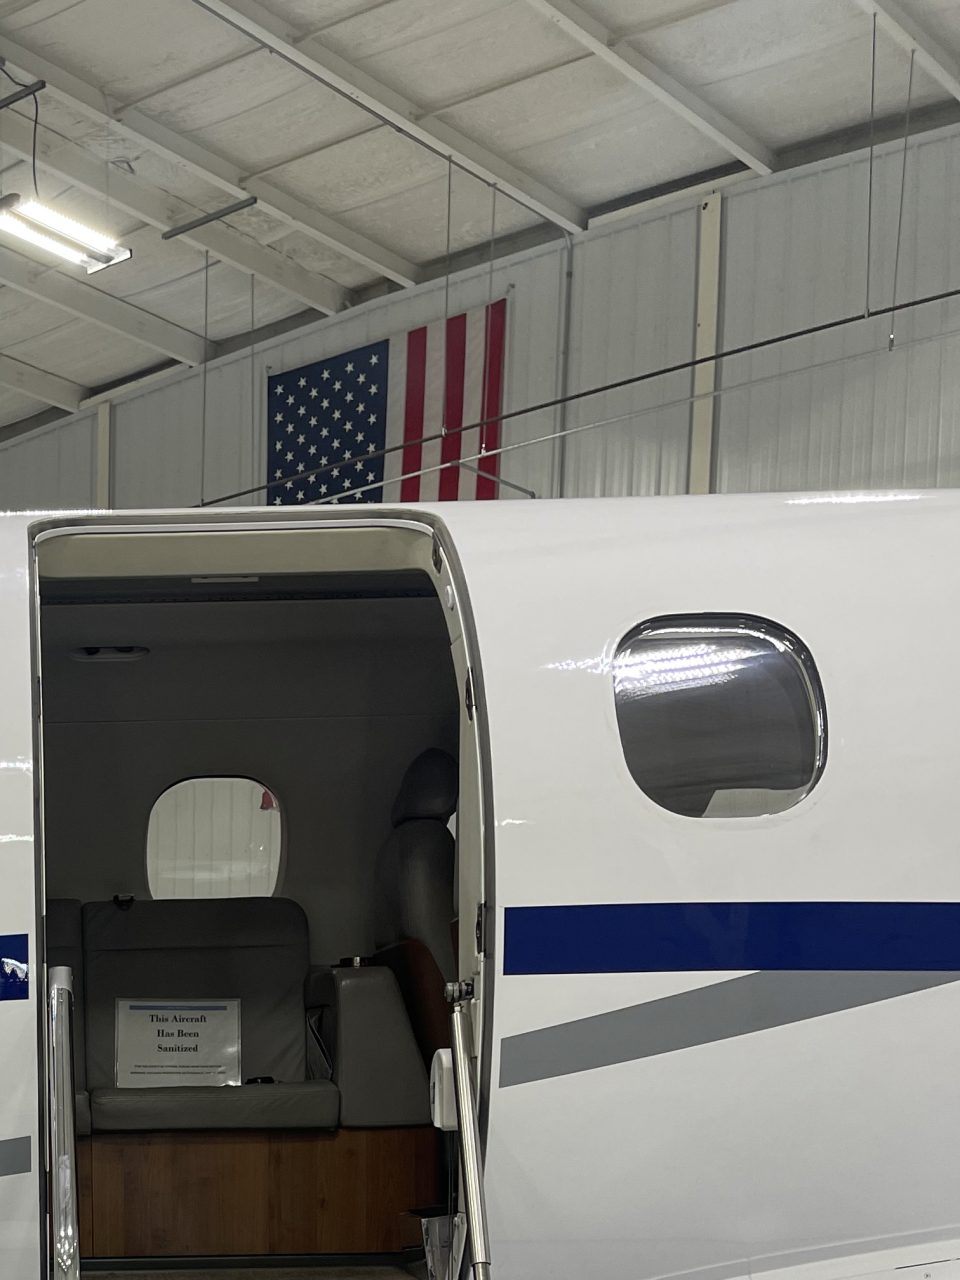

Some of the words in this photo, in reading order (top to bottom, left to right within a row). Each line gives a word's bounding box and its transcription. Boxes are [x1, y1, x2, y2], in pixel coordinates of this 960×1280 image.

[149, 1014, 169, 1023] This
[171, 1014, 207, 1023] Aircraft
[157, 1029, 174, 1038] Has
[177, 1029, 199, 1038] Been
[157, 1044, 198, 1053] Sanitized
